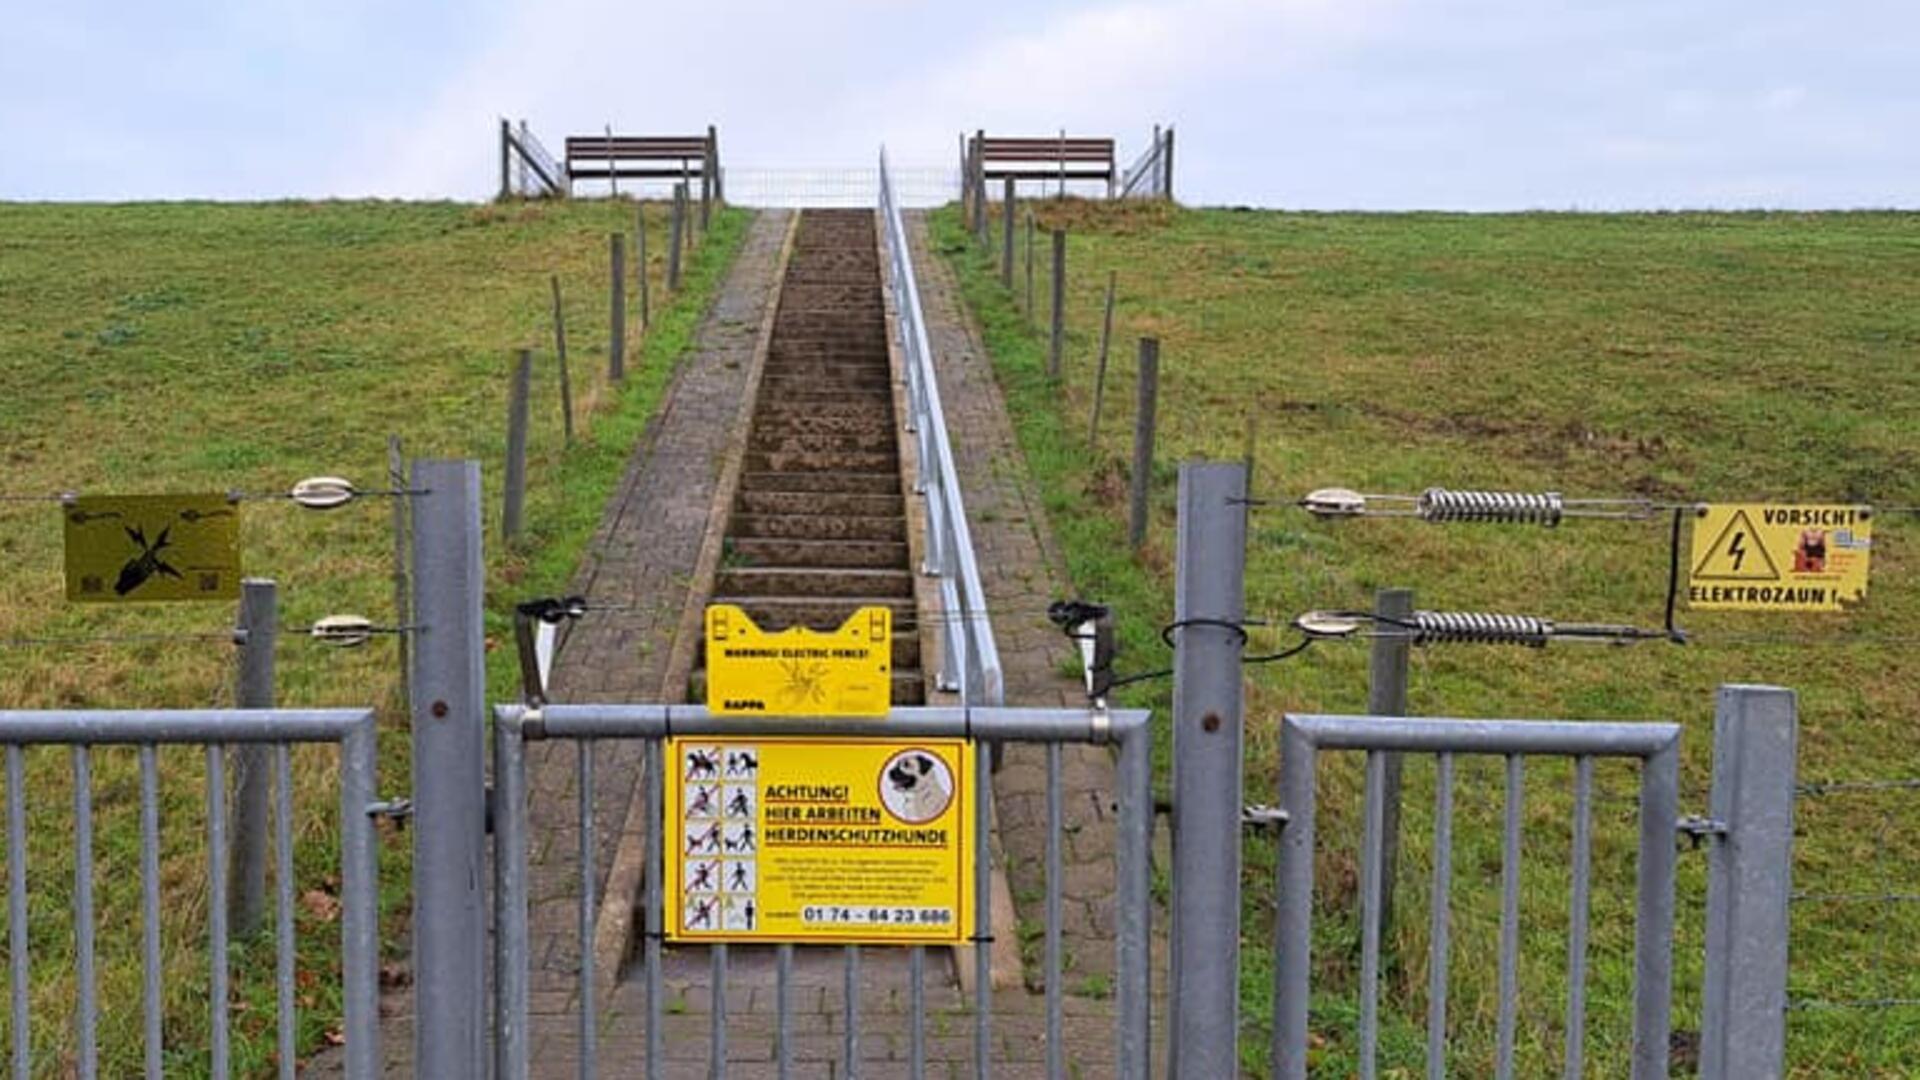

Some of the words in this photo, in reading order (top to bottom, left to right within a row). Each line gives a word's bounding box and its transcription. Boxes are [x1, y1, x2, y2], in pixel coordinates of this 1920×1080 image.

[1763, 509, 1856, 525] VORSICHT
[1689, 586, 1826, 604] ELEKTROZAUN
[782, 649, 829, 658] ELECTRIC
[765, 785, 849, 798] ACHTUNG!
[765, 807, 801, 819] HIER
[805, 807, 881, 820] ARBEITEN
[765, 828, 948, 843] HERDENSCHUTZHUNDE
[804, 907, 824, 921] 01
[831, 907, 850, 921] 74
[894, 908, 915, 922] 23
